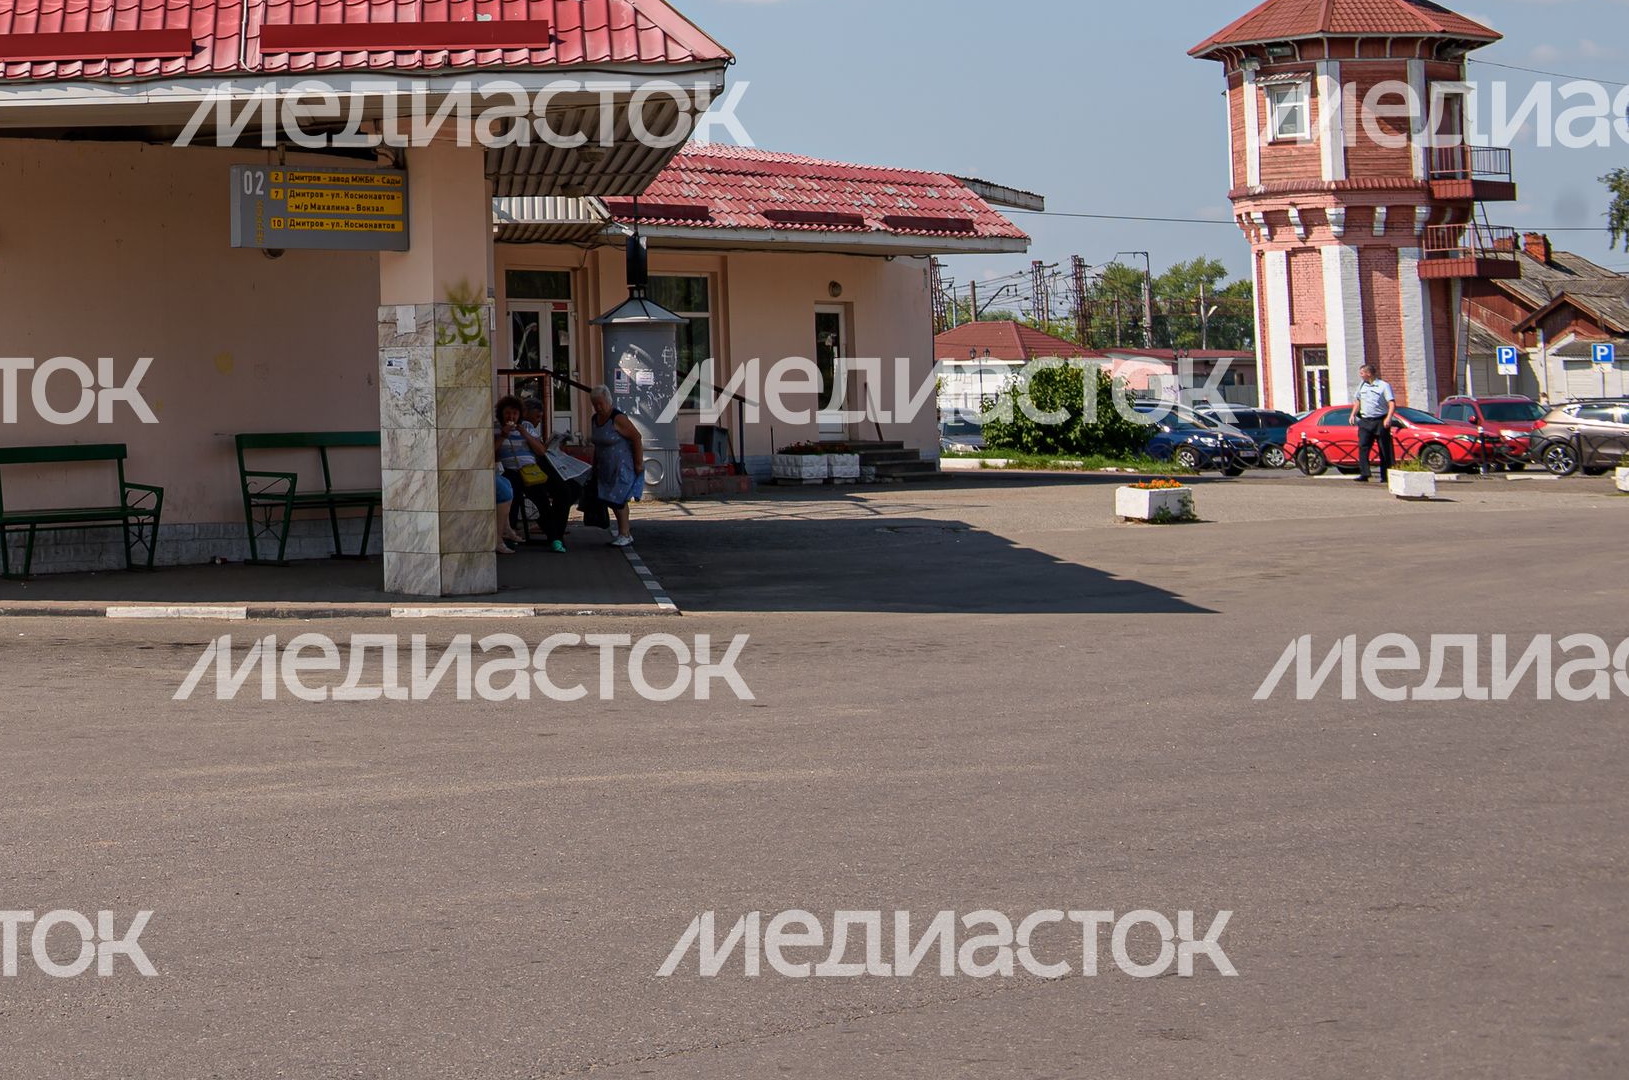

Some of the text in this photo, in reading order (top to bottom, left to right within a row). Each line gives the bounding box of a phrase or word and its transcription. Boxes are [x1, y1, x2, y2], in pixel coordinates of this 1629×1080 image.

[243, 170, 265, 196] 02
[274, 173, 280, 181] 2
[288, 173, 322, 183] Дмитров
[329, 176, 350, 184] завод
[351, 175, 375, 184] МЖБК
[381, 176, 401, 186] Сады
[274, 190, 279, 198] 7
[288, 190, 324, 200] Дмитров
[331, 192, 343, 200] ул.
[344, 191, 395, 201] Космонавтов
[295, 202, 308, 211] м/р
[311, 203, 350, 212] Махалина
[356, 204, 385, 213] Вокзал
[273, 219, 282, 228] 10
[289, 218, 324, 229] Дмитров
[331, 221, 343, 229] ул.
[344, 220, 396, 230] Космонавтов
